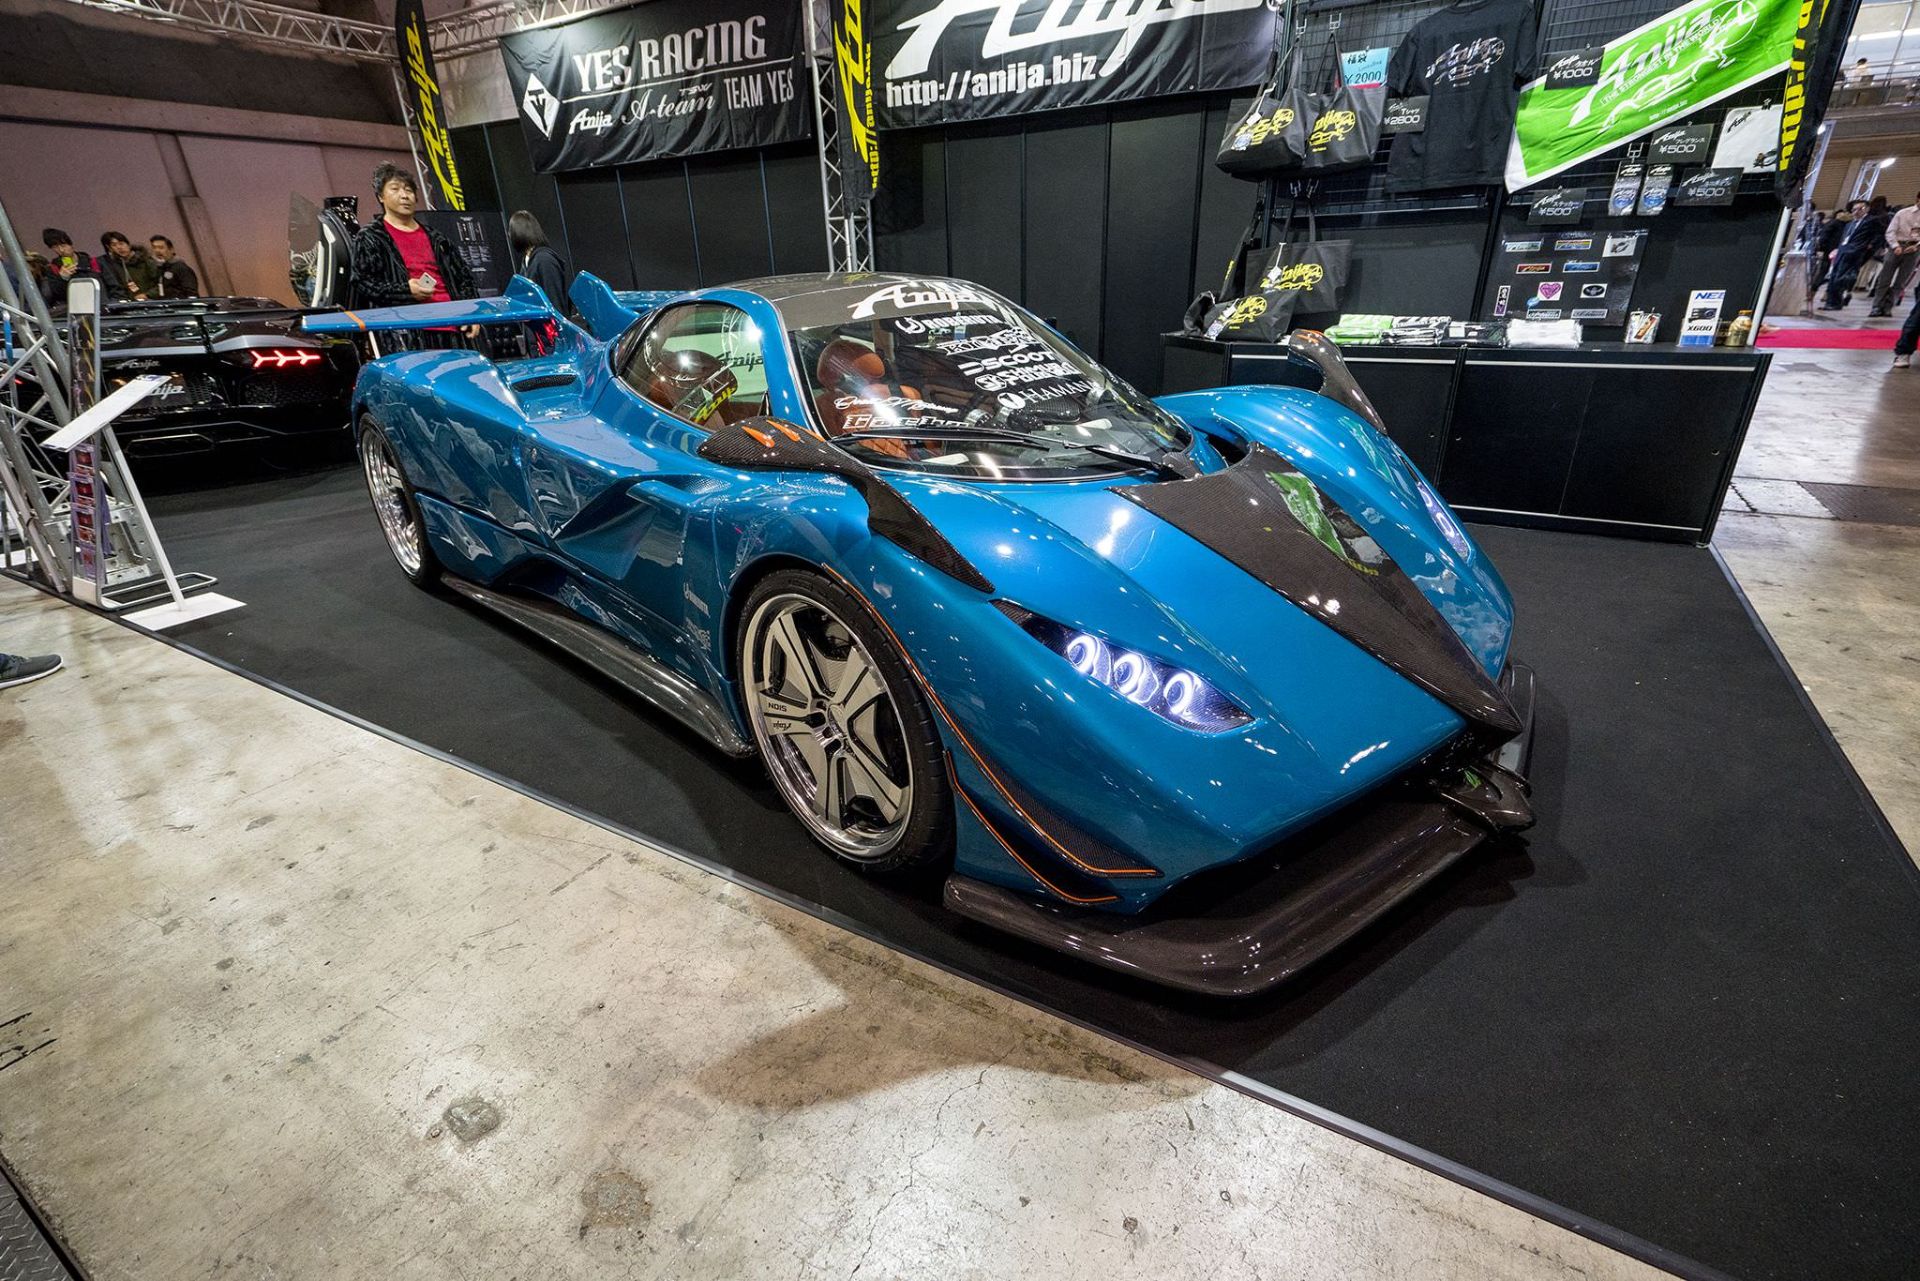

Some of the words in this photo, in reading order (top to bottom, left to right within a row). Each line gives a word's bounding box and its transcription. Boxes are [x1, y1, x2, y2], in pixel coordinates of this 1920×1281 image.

[573, 45, 631, 93] YES
[638, 15, 767, 80] RACING
[885, 53, 1098, 108] http://anija.biz
[1553, 67, 1593, 80] ¥1000
[679, 82, 712, 97] TSW
[724, 74, 764, 110] TEAM
[766, 67, 794, 104] YES
[621, 88, 716, 125] A-team
[1384, 115, 1420, 125] ¥2800
[569, 108, 613, 136] Anija
[1659, 144, 1697, 154] ¥500
[1688, 187, 1725, 197] ¥500
[848, 284, 996, 319] Anija
